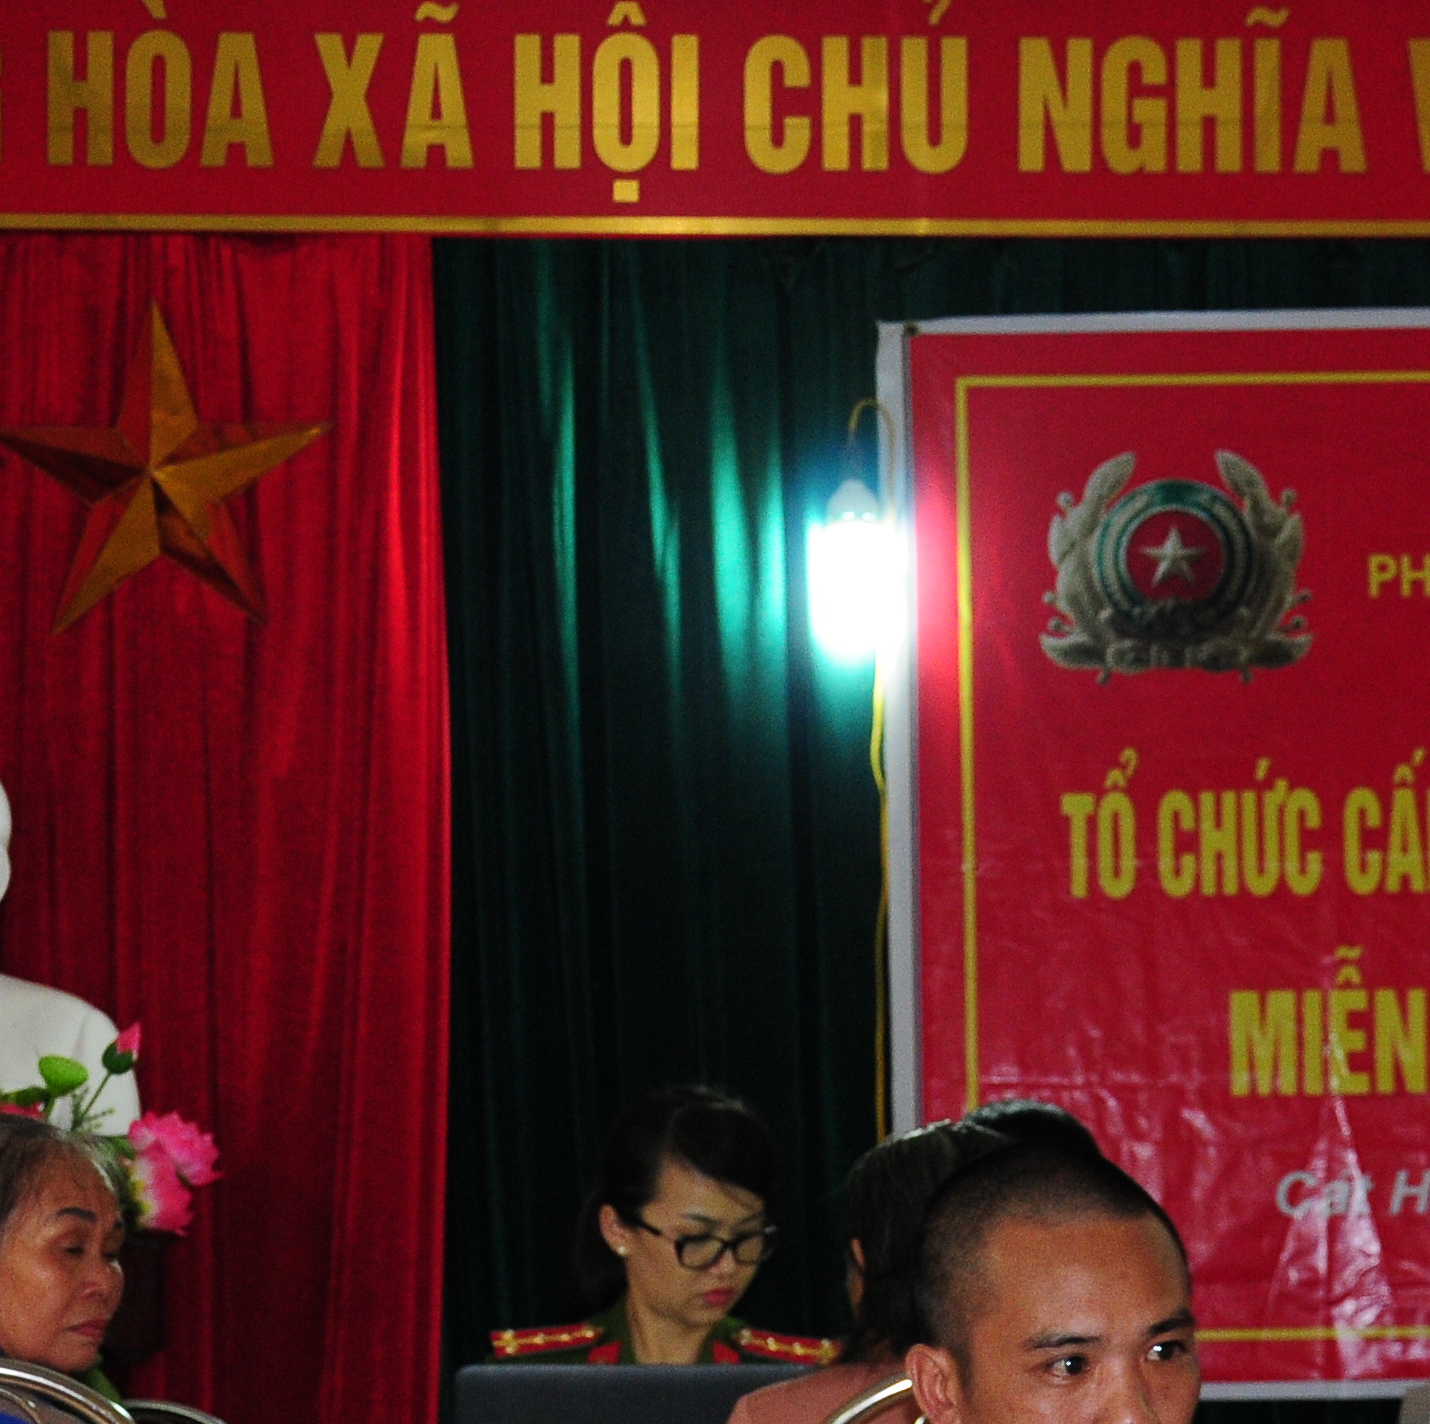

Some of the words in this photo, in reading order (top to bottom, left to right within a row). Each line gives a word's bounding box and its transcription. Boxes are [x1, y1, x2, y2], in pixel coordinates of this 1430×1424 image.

[45, 0, 274, 169] HÒA
[312, 2, 474, 168] XÃ
[513, 1, 699, 203] HỘI
[743, 0, 968, 174] CHỦ
[1018, 8, 1367, 174] NGHĨA
[1061, 748, 1138, 899] TỔ
[1157, 758, 1321, 897] CHỨC
[1229, 945, 1427, 1097] MIỄN
